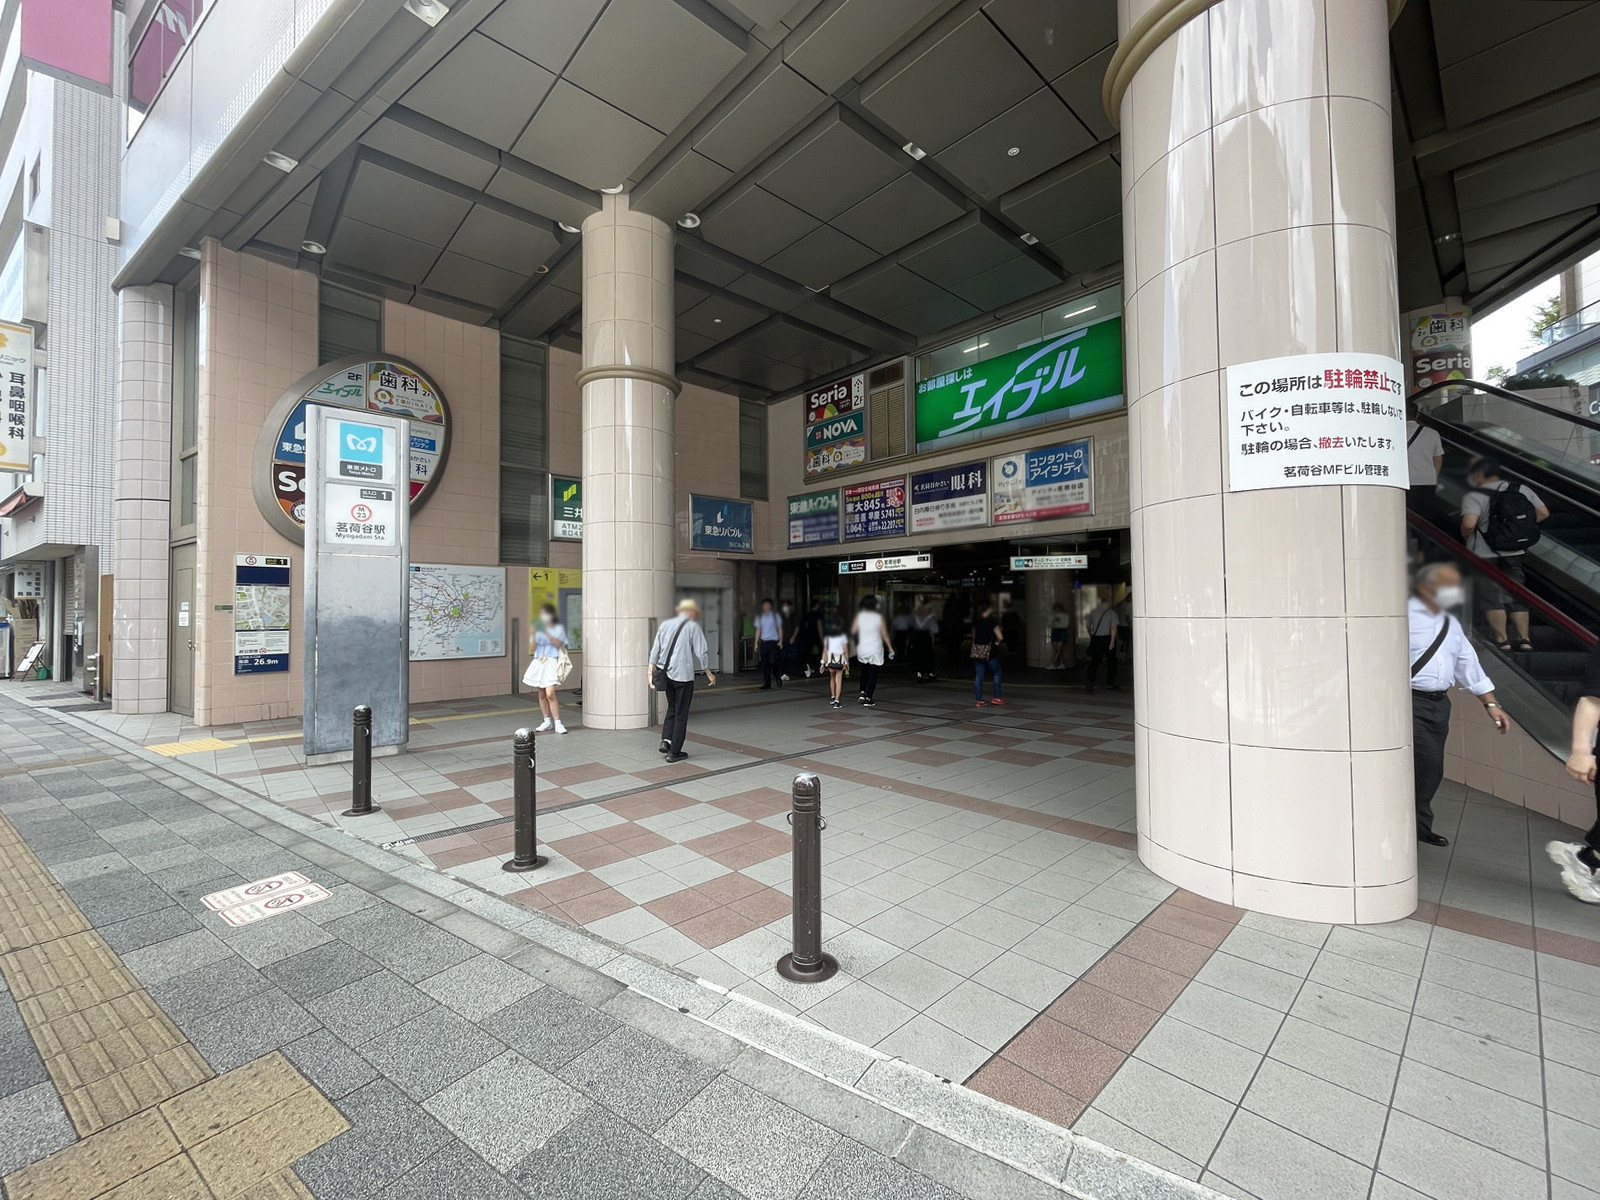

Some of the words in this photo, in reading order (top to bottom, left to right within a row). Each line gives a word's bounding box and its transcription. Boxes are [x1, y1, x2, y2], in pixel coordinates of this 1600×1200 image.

[1430, 318, 1464, 335] 歯科
[1416, 352, 1471, 374] Seria
[347, 373, 363, 382] 2F
[380, 370, 419, 394] 歯科
[938, 327, 1088, 438] エイブル
[317, 382, 363, 397] エイブル
[810, 384, 847, 409] Seria
[8, 371, 26, 440] 耳鼻咽喉科
[853, 394, 864, 407] 2F
[823, 419, 858, 440] NOVA
[1240, 421, 1290, 437] 下さい。
[1030, 449, 1083, 468] コンタクトの
[1030, 462, 1083, 481] アイシティ
[1283, 464, 1389, 478] 茗荷谷MFビル管理者
[951, 470, 983, 491] 眼科
[380, 491, 387, 500] 1
[563, 506, 582, 518] 三井
[336, 522, 386, 534] 茗荷谷駅
[704, 525, 743, 538] 東急リバブル
[335, 532, 374, 541] Myogadani
[544, 573, 549, 581] 1
[254, 657, 280, 666] 26.9m
